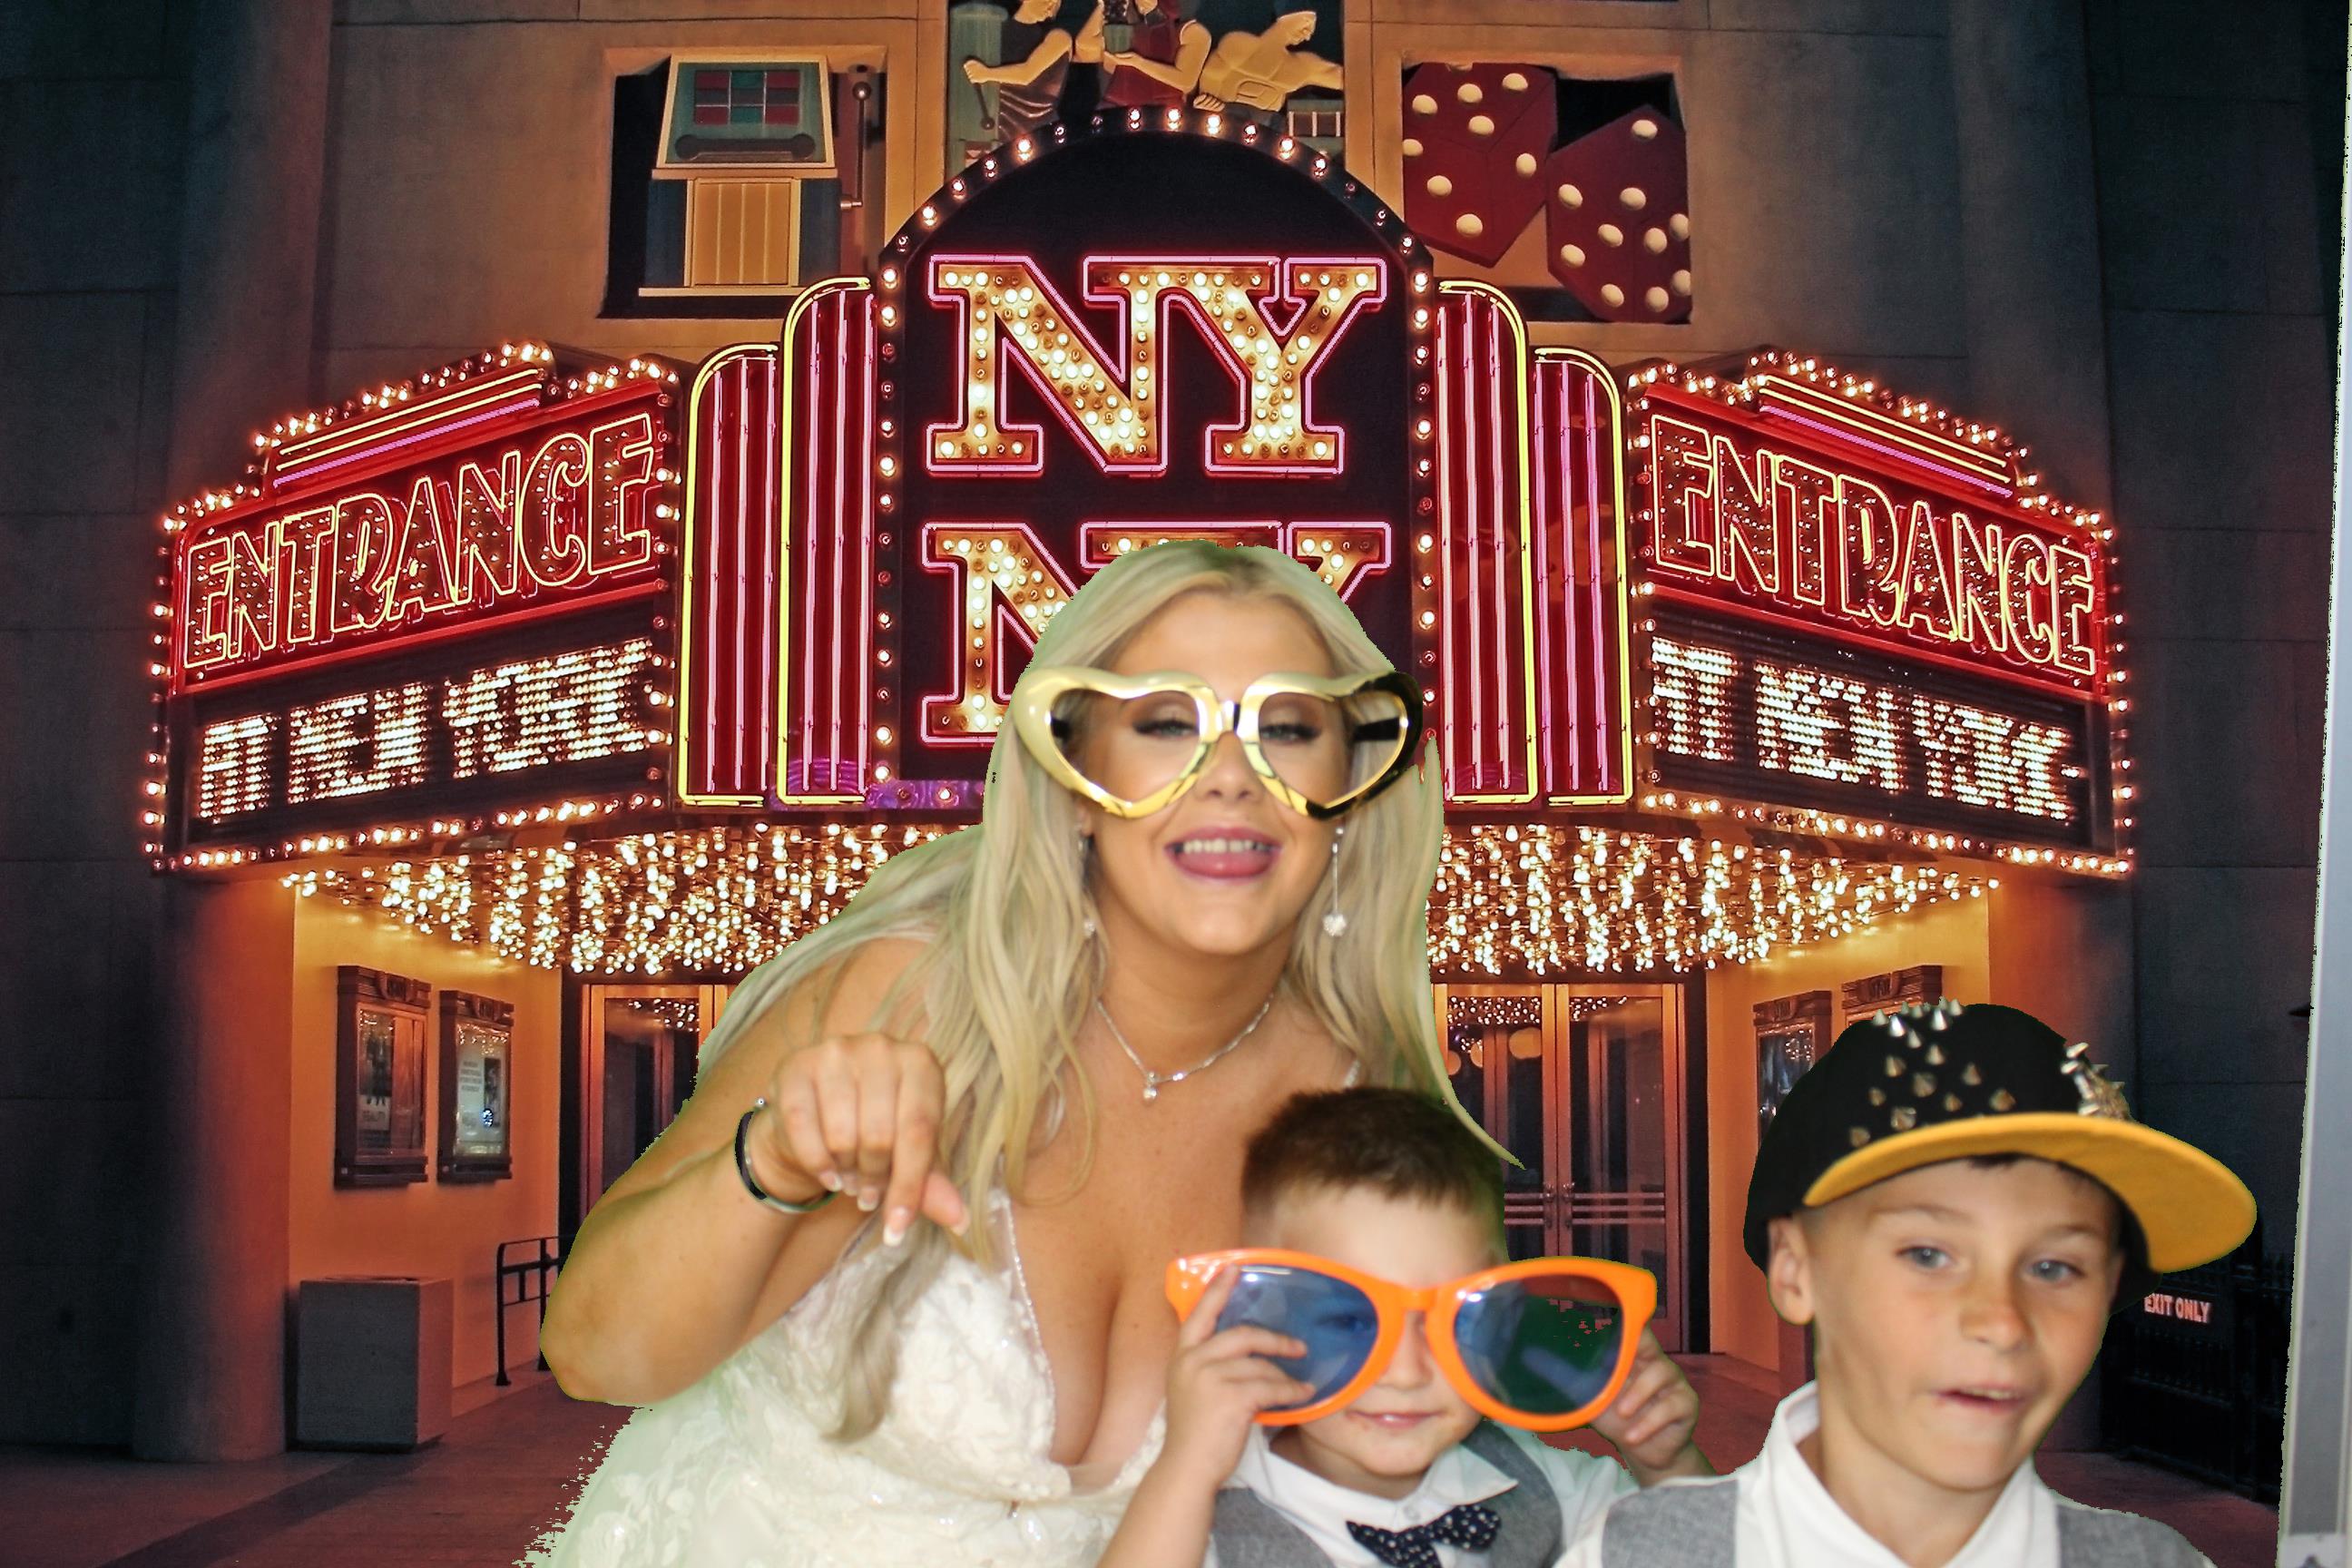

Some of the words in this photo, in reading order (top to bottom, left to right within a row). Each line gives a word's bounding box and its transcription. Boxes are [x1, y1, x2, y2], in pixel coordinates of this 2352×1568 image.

[927, 253, 1387, 475] NY
[184, 413, 654, 668] ENTRANCE
[1651, 414, 2097, 676] ENTRANCE
[2144, 1293, 2172, 1316] EXIT
[2175, 1297, 2210, 1323] ONLY
